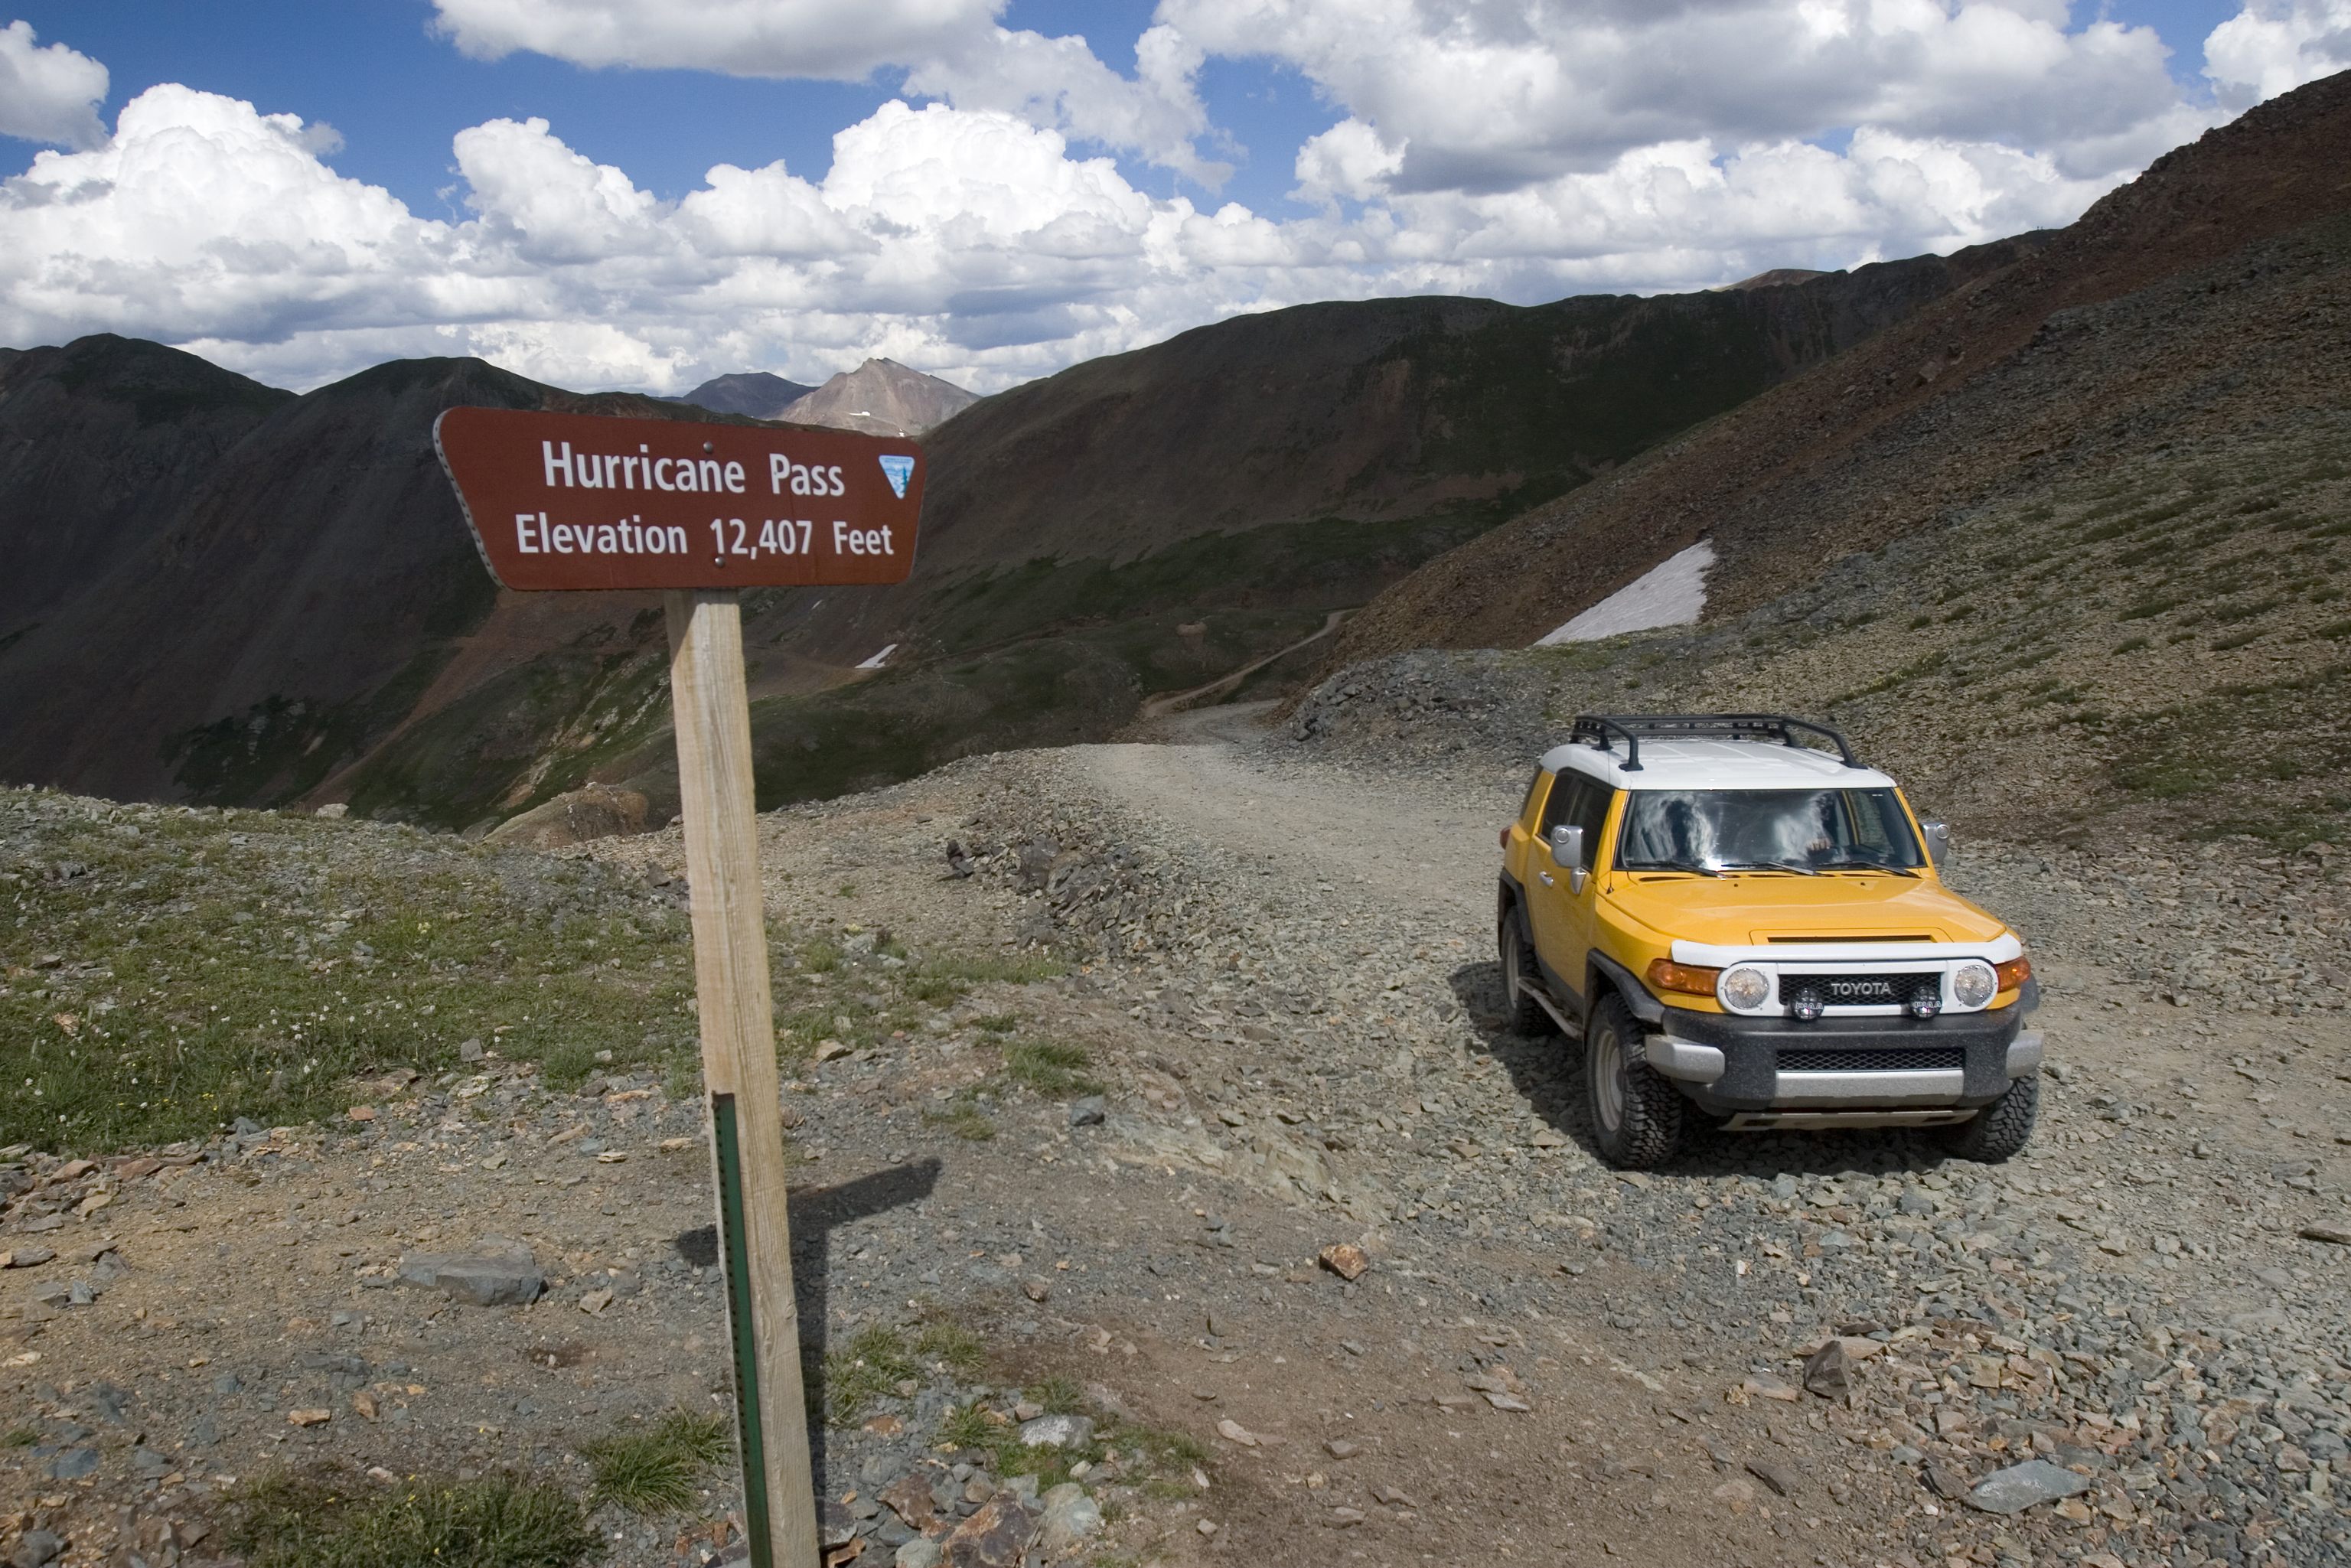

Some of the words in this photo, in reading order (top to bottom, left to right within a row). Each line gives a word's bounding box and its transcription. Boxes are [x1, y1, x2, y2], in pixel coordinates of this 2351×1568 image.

[541, 439, 746, 494] Hurricane
[768, 452, 846, 497] Pass
[514, 510, 689, 555] Elevation
[709, 517, 814, 560] 12,407
[832, 520, 895, 556] Feet
[1831, 983, 1891, 996] TOYOTA
